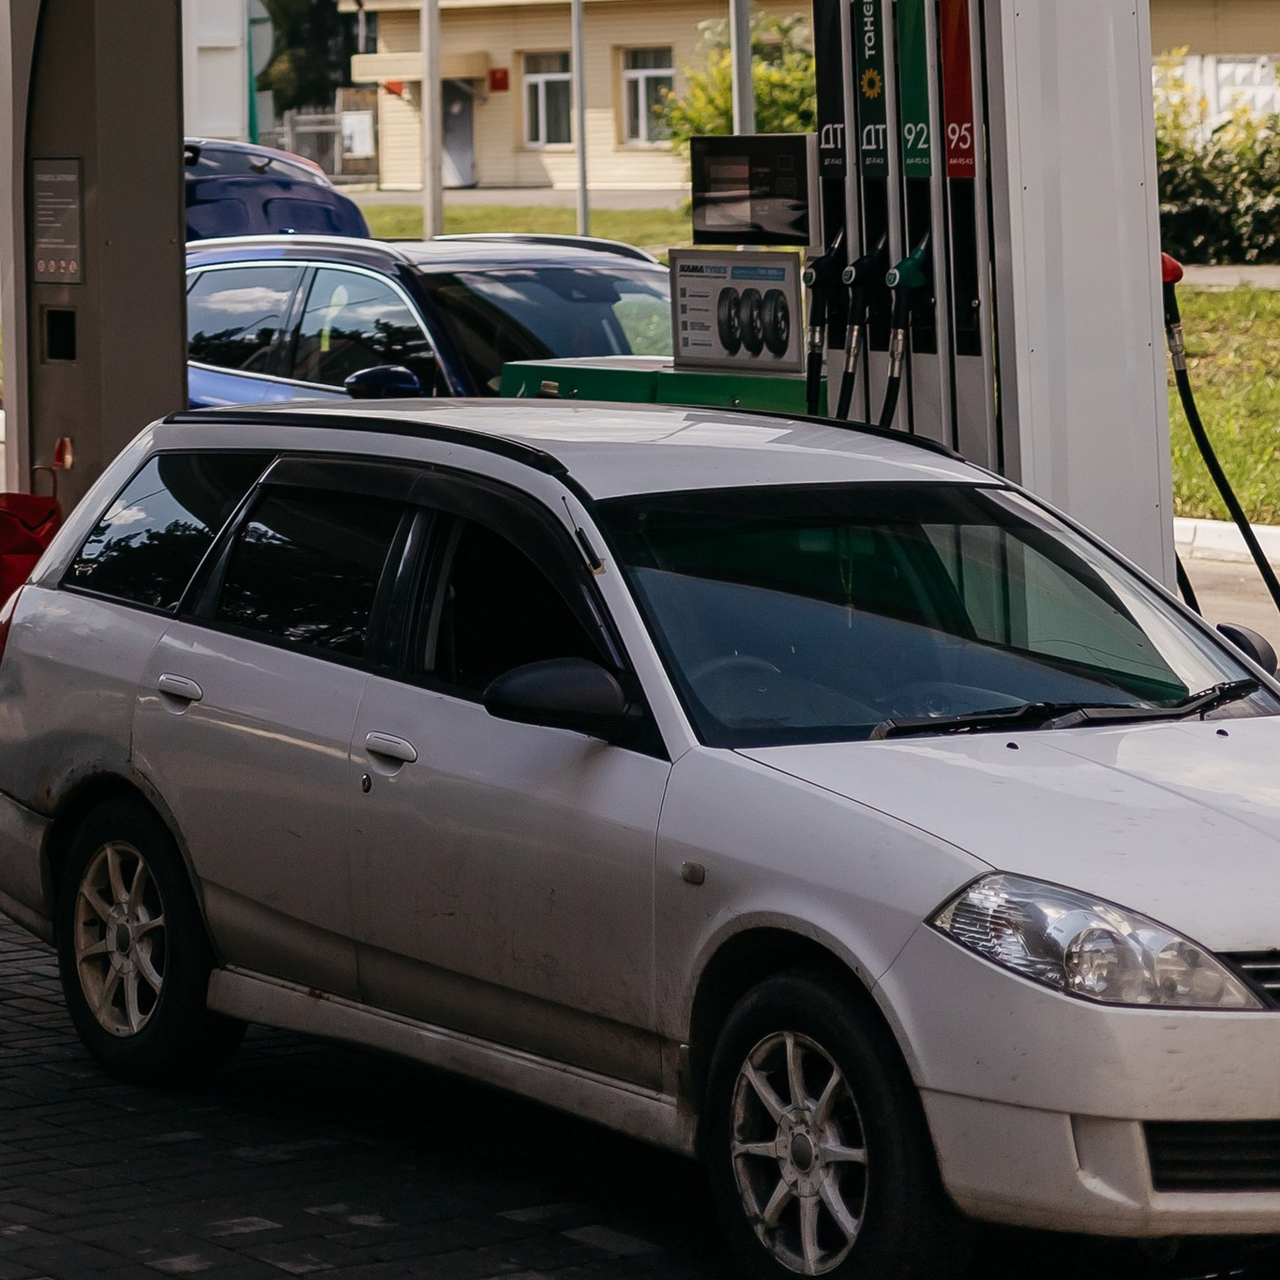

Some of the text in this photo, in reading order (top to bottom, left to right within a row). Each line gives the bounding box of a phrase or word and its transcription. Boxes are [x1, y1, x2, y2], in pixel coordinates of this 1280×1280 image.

[821, 124, 844, 148] ДТ
[862, 125, 886, 149] ДТ
[904, 123, 928, 149] 92
[948, 123, 971, 149] 95
